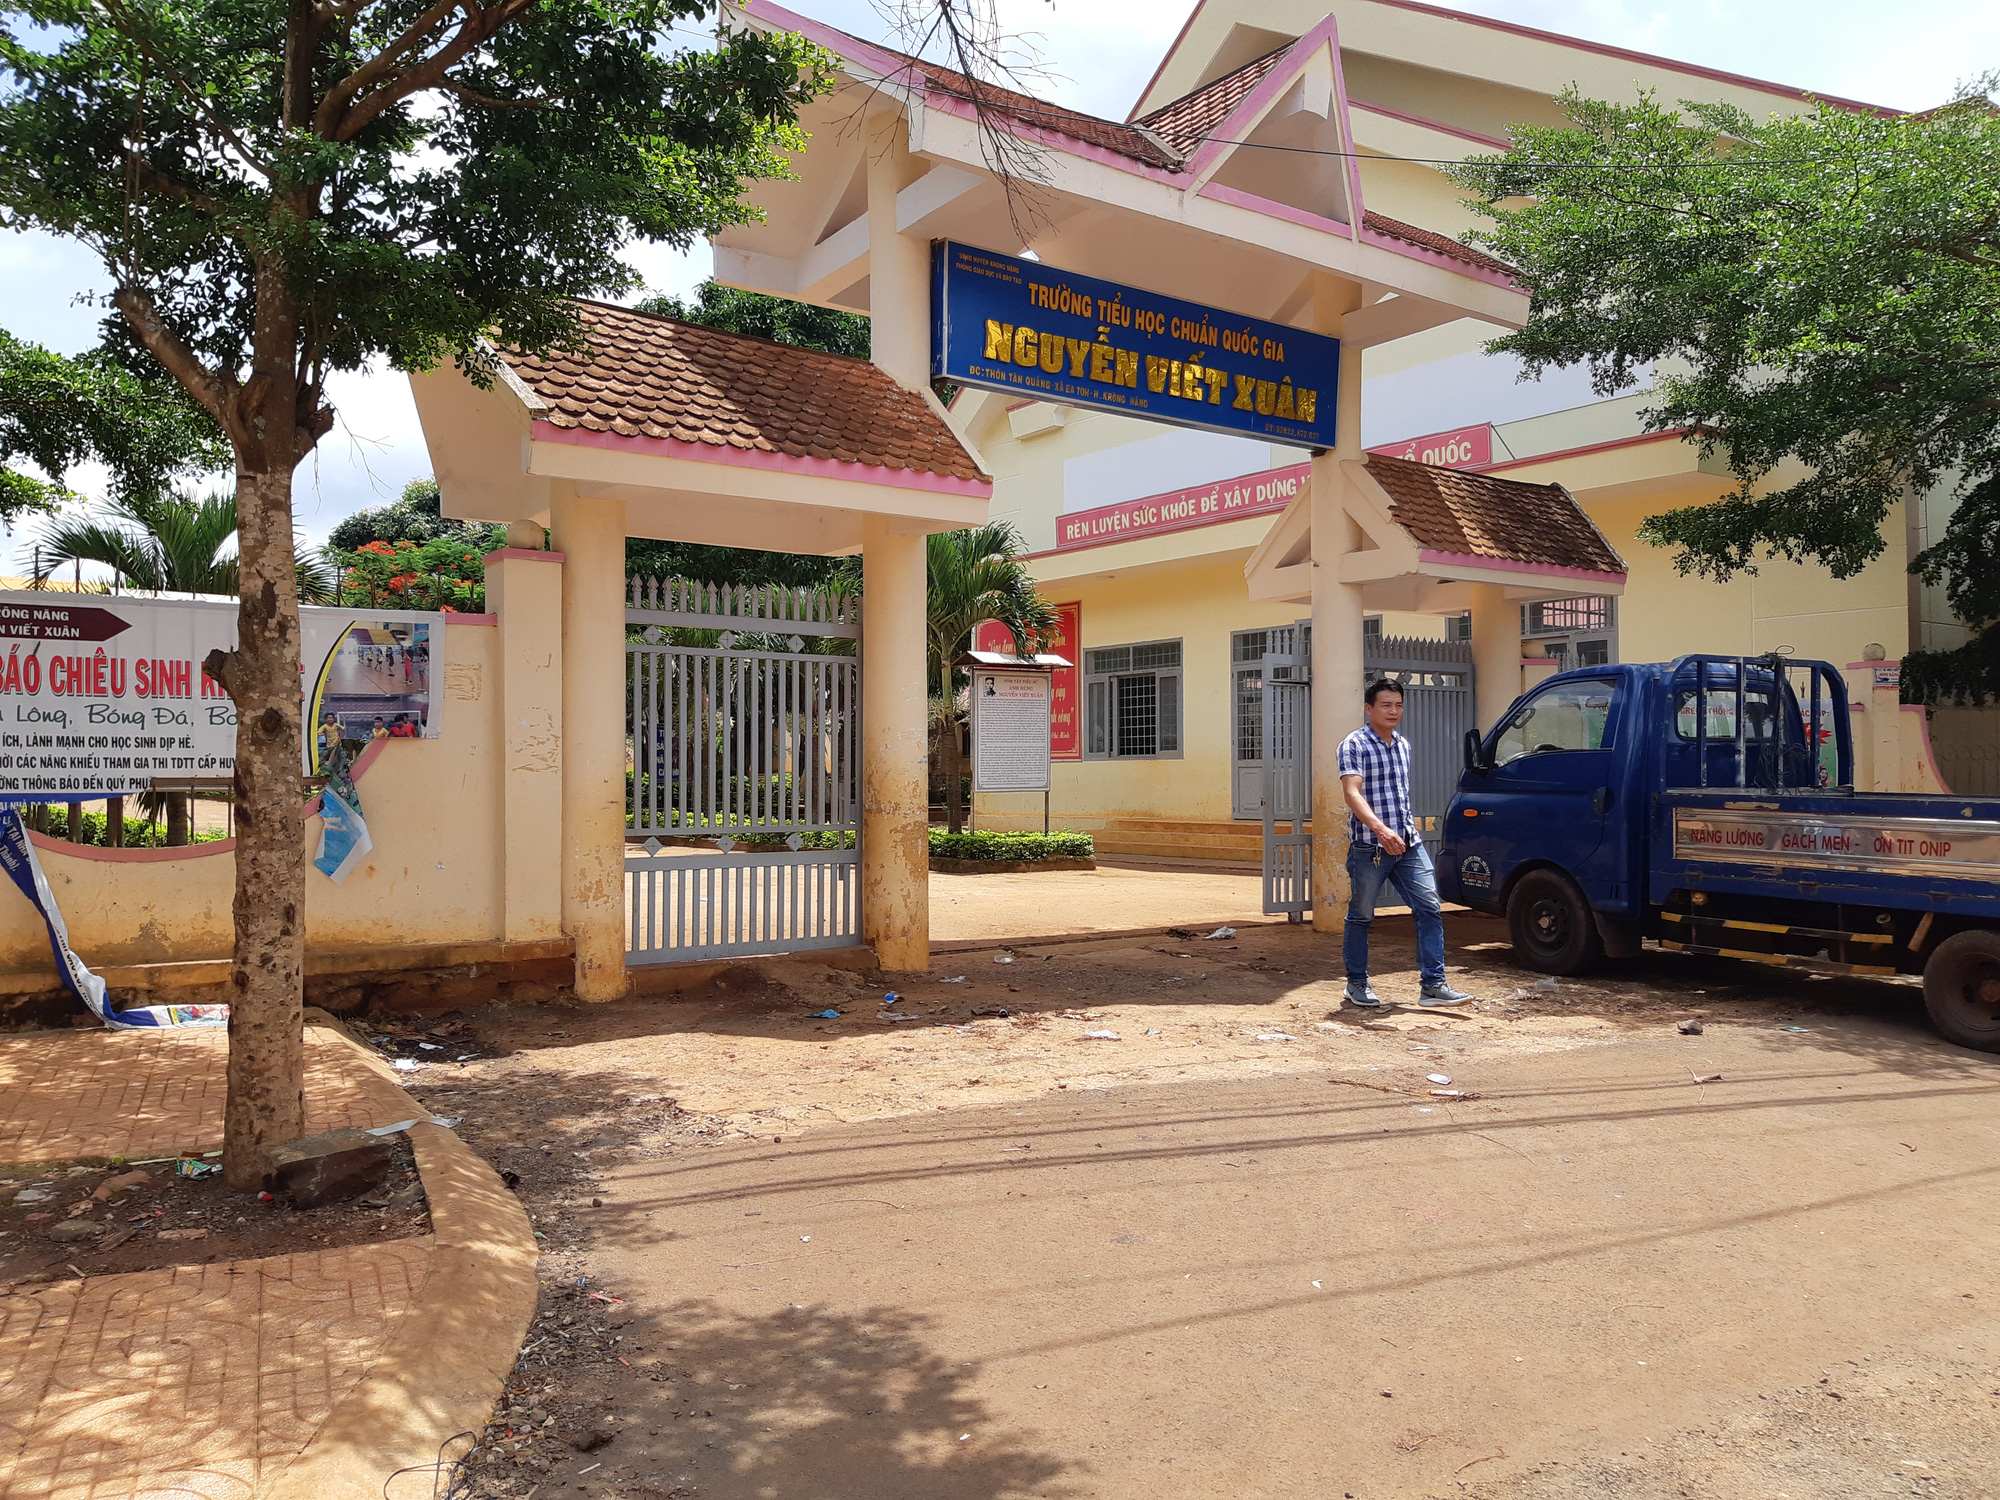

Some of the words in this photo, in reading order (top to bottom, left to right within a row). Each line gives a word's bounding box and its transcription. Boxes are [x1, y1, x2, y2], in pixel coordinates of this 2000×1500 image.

[1028, 282, 1092, 318] TRƯỜNG
[1097, 291, 1131, 328] TIỂU
[1135, 308, 1166, 339] HỌC
[1170, 313, 1218, 347] CHUẨN
[1222, 326, 1259, 356] QUỐC
[1262, 339, 1285, 362] GIA
[984, 318, 1139, 388] NGUYỄN
[1145, 350, 1228, 405] VIẾT
[1232, 375, 1317, 424] XUÂN
[1422, 435, 1472, 467] QUỐC
[1066, 519, 1090, 540] RÈN
[1092, 510, 1130, 533] LUYỆN
[1132, 504, 1158, 527] SỨC
[1161, 495, 1197, 522] KHỎE
[1200, 486, 1220, 514] ĐỂ
[1223, 485, 1252, 510] XÂY
[1256, 478, 1297, 504] DỰNG
[0, 606, 29, 620] ÔNG
[33, 609, 70, 621] NĂNG
[10, 622, 40, 636] VIẾT
[44, 625, 80, 638] XUÂN
[49, 646, 127, 697] CHIÊU
[135, 658, 192, 699] SINH
[16, 705, 73, 730] Lông,
[84, 703, 145, 730] Bóng
[151, 707, 194, 727] Đá,
[26, 731, 53, 748] LÀNH
[56, 736, 85, 751] MẠNH
[88, 736, 108, 749] CHO
[111, 737, 131, 751] HỌC
[134, 737, 156, 749] SINH
[159, 737, 176, 751] DỊP
[178, 734, 195, 749] HÈ.
[0, 753, 13, 769] ỜI
[16, 753, 37, 769] CÁC
[40, 754, 67, 769] NĂNG
[70, 752, 100, 769] KHIẾU
[103, 757, 131, 769] THAM
[134, 757, 150, 769] GIA
[152, 757, 168, 769] THI
[171, 758, 195, 769] TDTT
[198, 754, 217, 769] CẤP
[22, 774, 57, 790] THÔNG
[59, 774, 80, 790] BÁO
[83, 773, 104, 790] ĐẾN
[106, 775, 126, 792] QUÝ
[1821, 835, 1850, 852] MEN
[1896, 838, 1915, 855] TIT
[1919, 840, 1952, 858] ONIP
